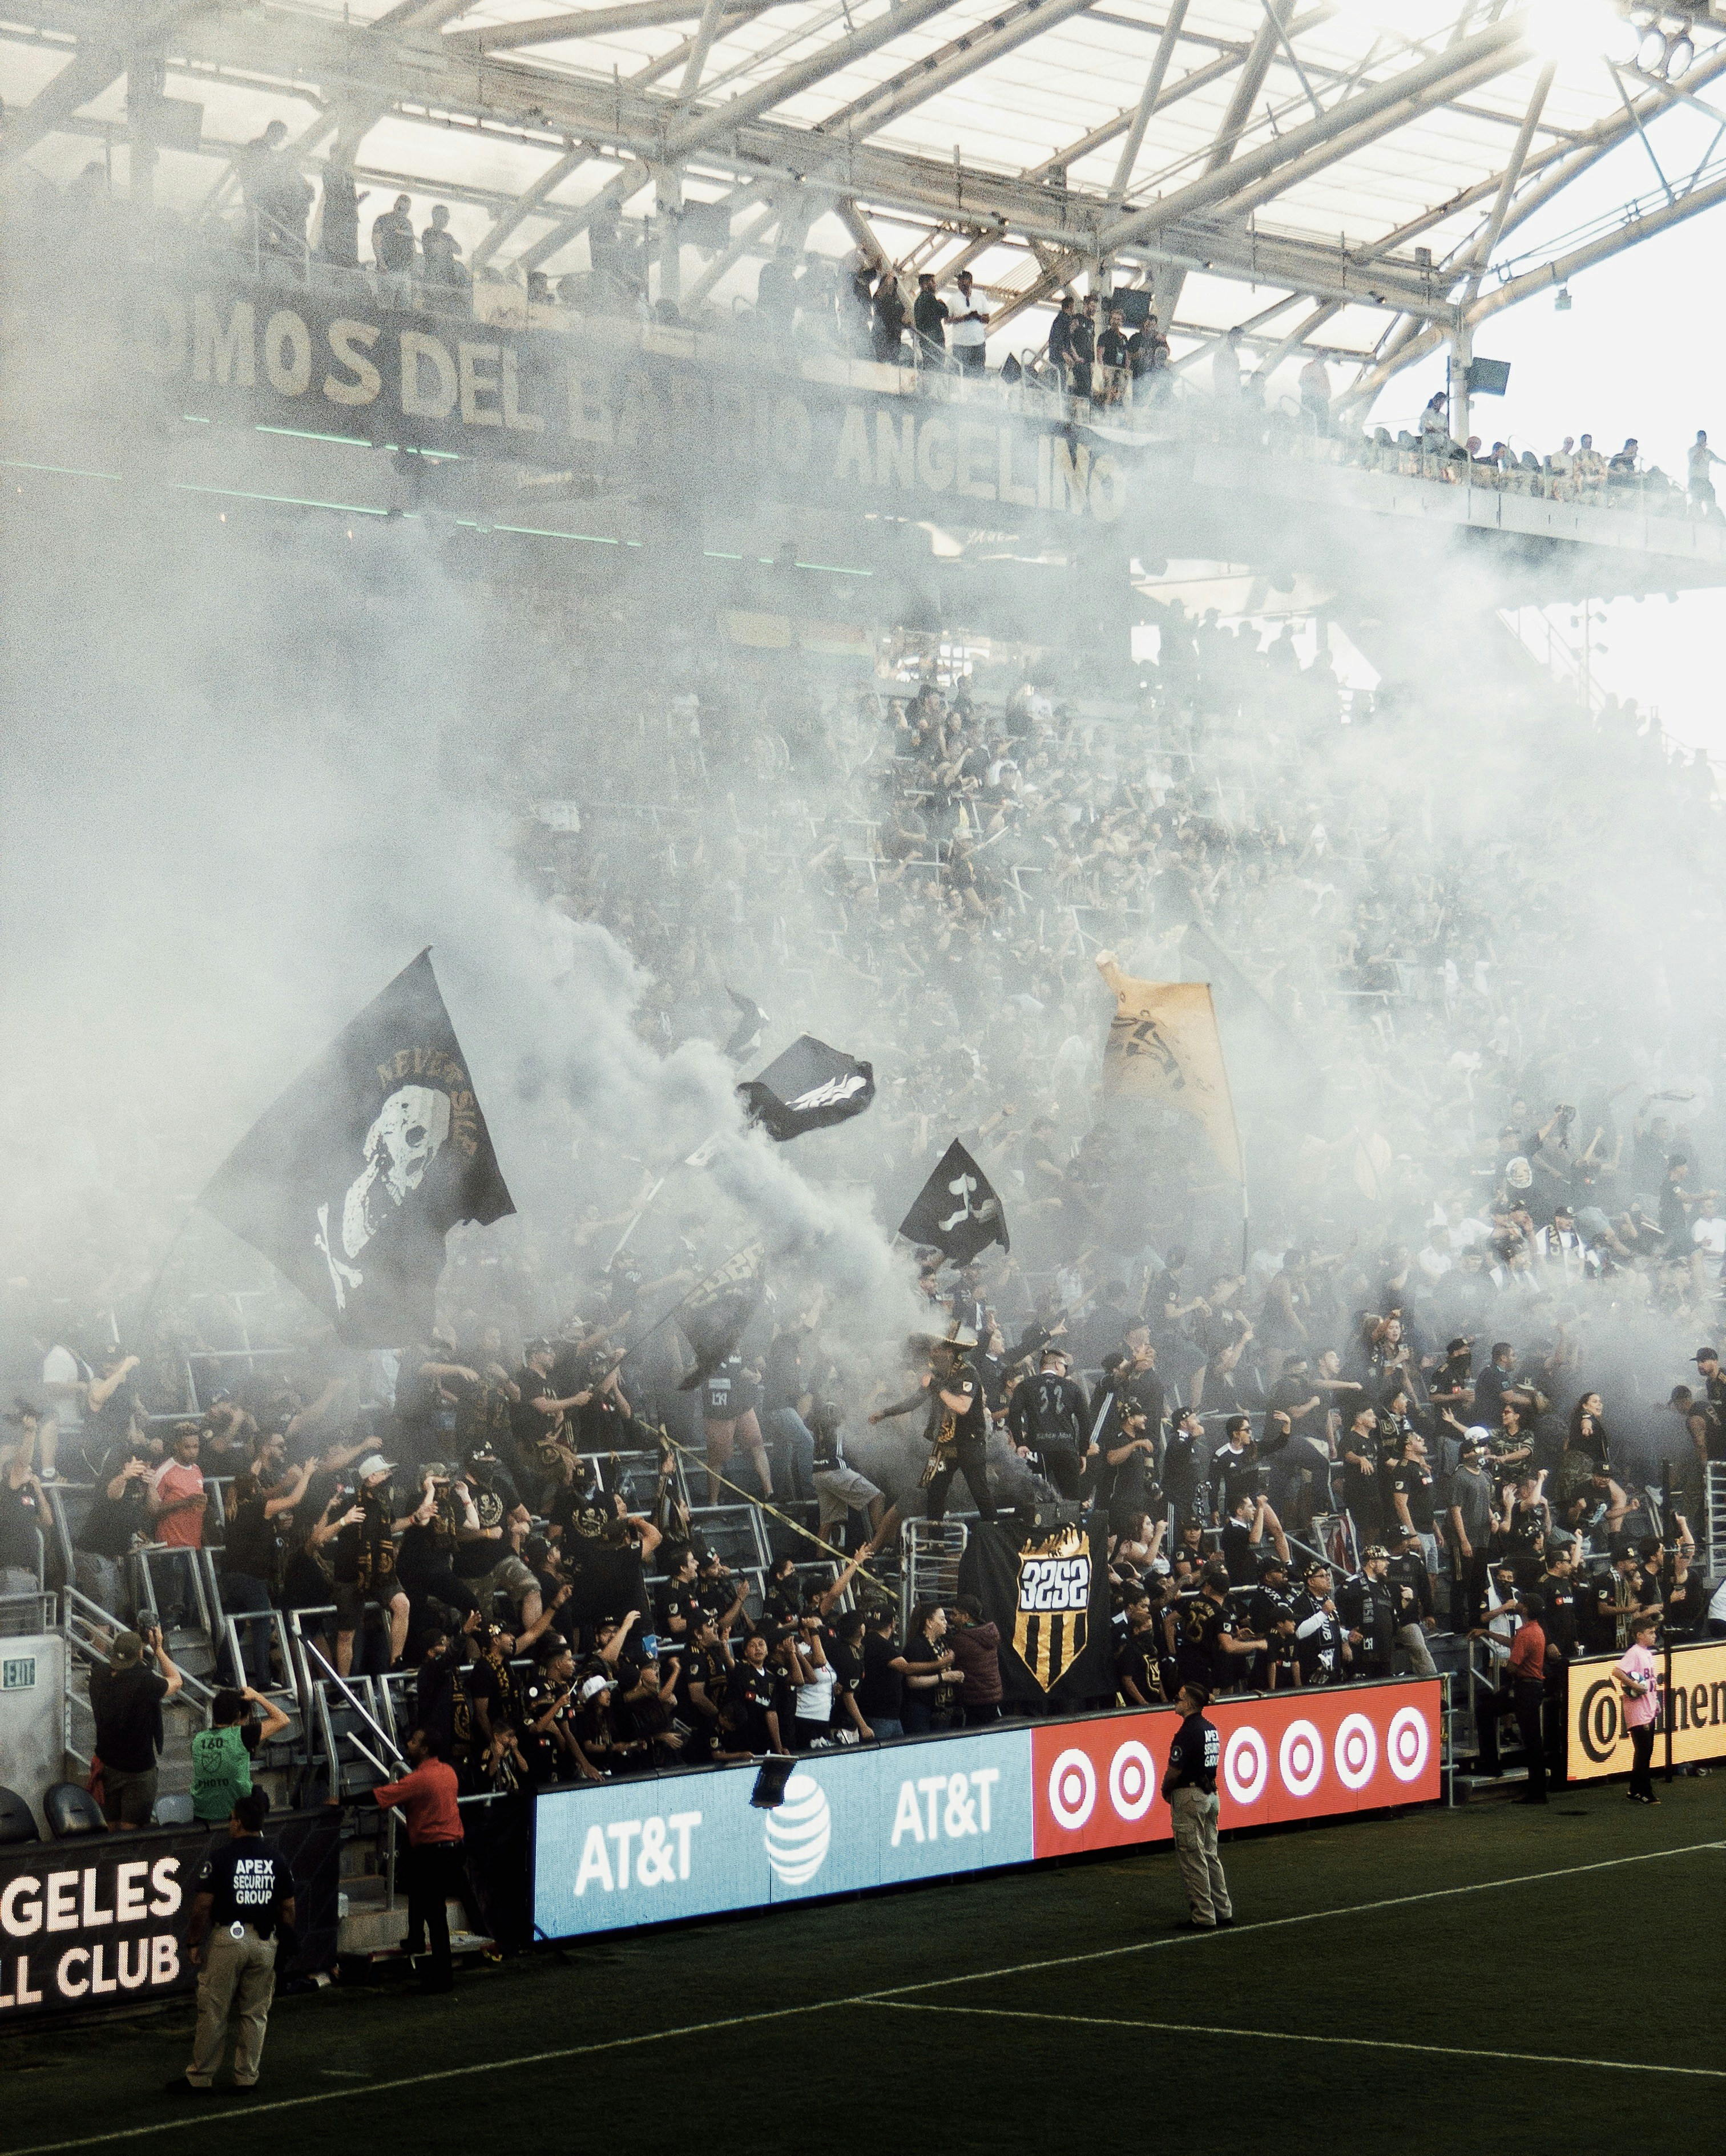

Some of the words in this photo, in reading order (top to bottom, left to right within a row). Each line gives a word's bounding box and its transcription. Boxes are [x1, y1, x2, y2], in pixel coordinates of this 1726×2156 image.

[401, 331, 545, 433] DEL
[1021, 1559, 1088, 1610] 3252
[7, 1660, 32, 1686] EXIT
[201, 1737, 223, 1750] 160
[198, 1778, 229, 1788] PHOTO
[891, 1768, 999, 1847] AT&T
[236, 1859, 273, 1874] APEX
[574, 1811, 703, 1896] AT&T
[0, 1856, 183, 1937] GELES
[233, 1875, 275, 1889] SECURITY
[236, 1889, 272, 1904] GROUP
[57, 1935, 180, 1997] CLUB
